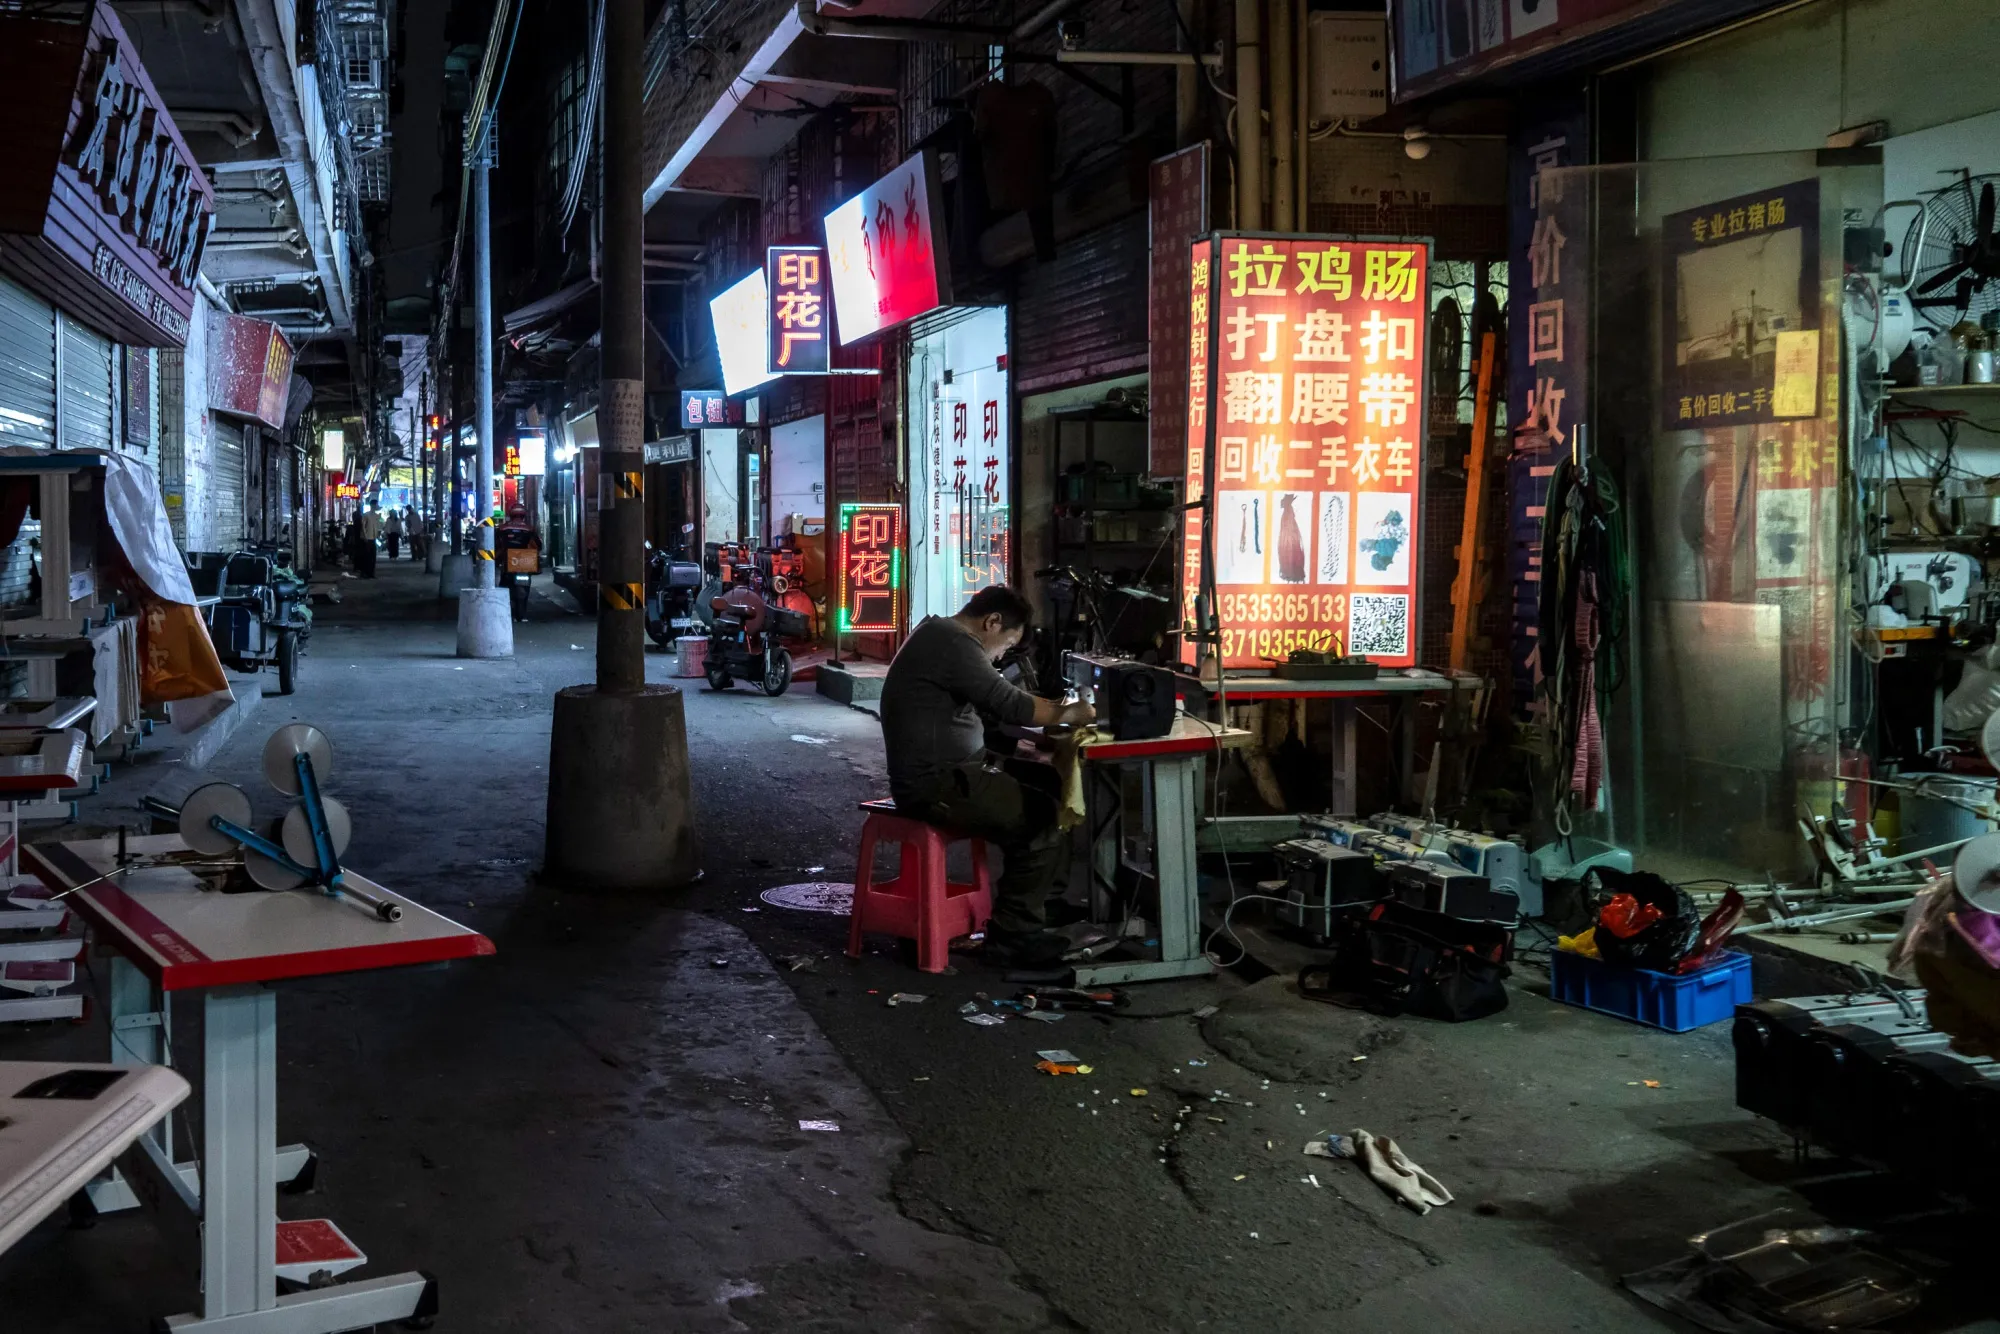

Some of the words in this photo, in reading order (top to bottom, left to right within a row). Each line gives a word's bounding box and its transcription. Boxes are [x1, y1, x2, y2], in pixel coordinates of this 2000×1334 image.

[1691, 196, 1787, 244] 专业拉猪肠
[1228, 243, 1418, 303] 拉鸡肠
[776, 253, 821, 367] 印花厂
[1226, 306, 1415, 365] 打盘扣
[1188, 258, 1208, 428] 鸿悦针车行
[1223, 370, 1415, 428] 翻腰带
[1679, 387, 1775, 420] 高价回收二手
[983, 399, 1000, 507] 印花
[1219, 434, 1413, 487] 回收二手衣车
[850, 513, 890, 624] 印花厂
[1210, 628, 1344, 658] 3719355021
